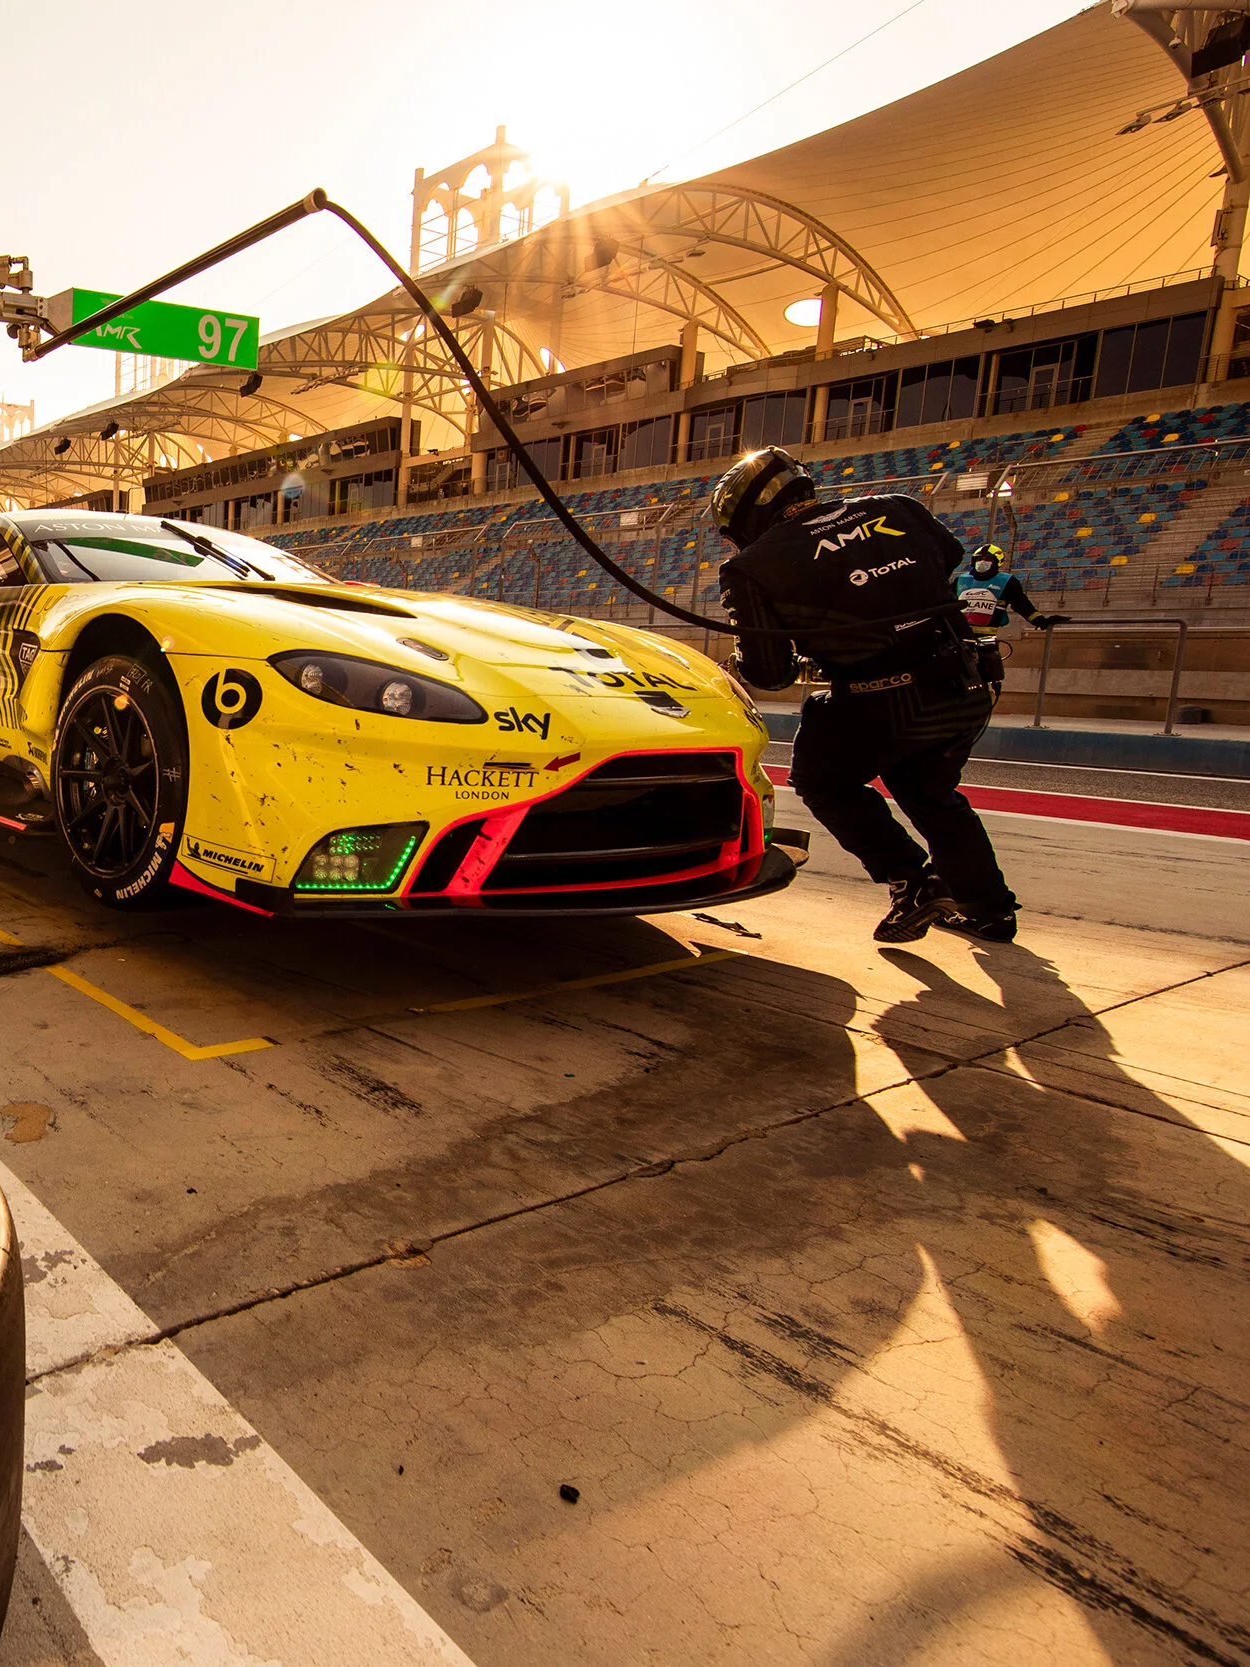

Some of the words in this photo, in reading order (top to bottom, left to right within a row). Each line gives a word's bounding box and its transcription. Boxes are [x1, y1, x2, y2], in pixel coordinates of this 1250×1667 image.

[198, 314, 248, 362] 97
[35, 523, 127, 533] ASTON
[810, 523, 836, 536] ASTON
[836, 510, 867, 526] MARTIN
[813, 516, 906, 560] AMR
[868, 557, 917, 578] TOTAL
[548, 666, 697, 692] TOTAL
[849, 672, 913, 694] sparco
[494, 707, 550, 740] sky
[426, 766, 539, 787] HACKETT
[455, 791, 509, 800] LONDON
[202, 848, 265, 873] MICHELIN
[115, 851, 163, 901] MICHELIN
